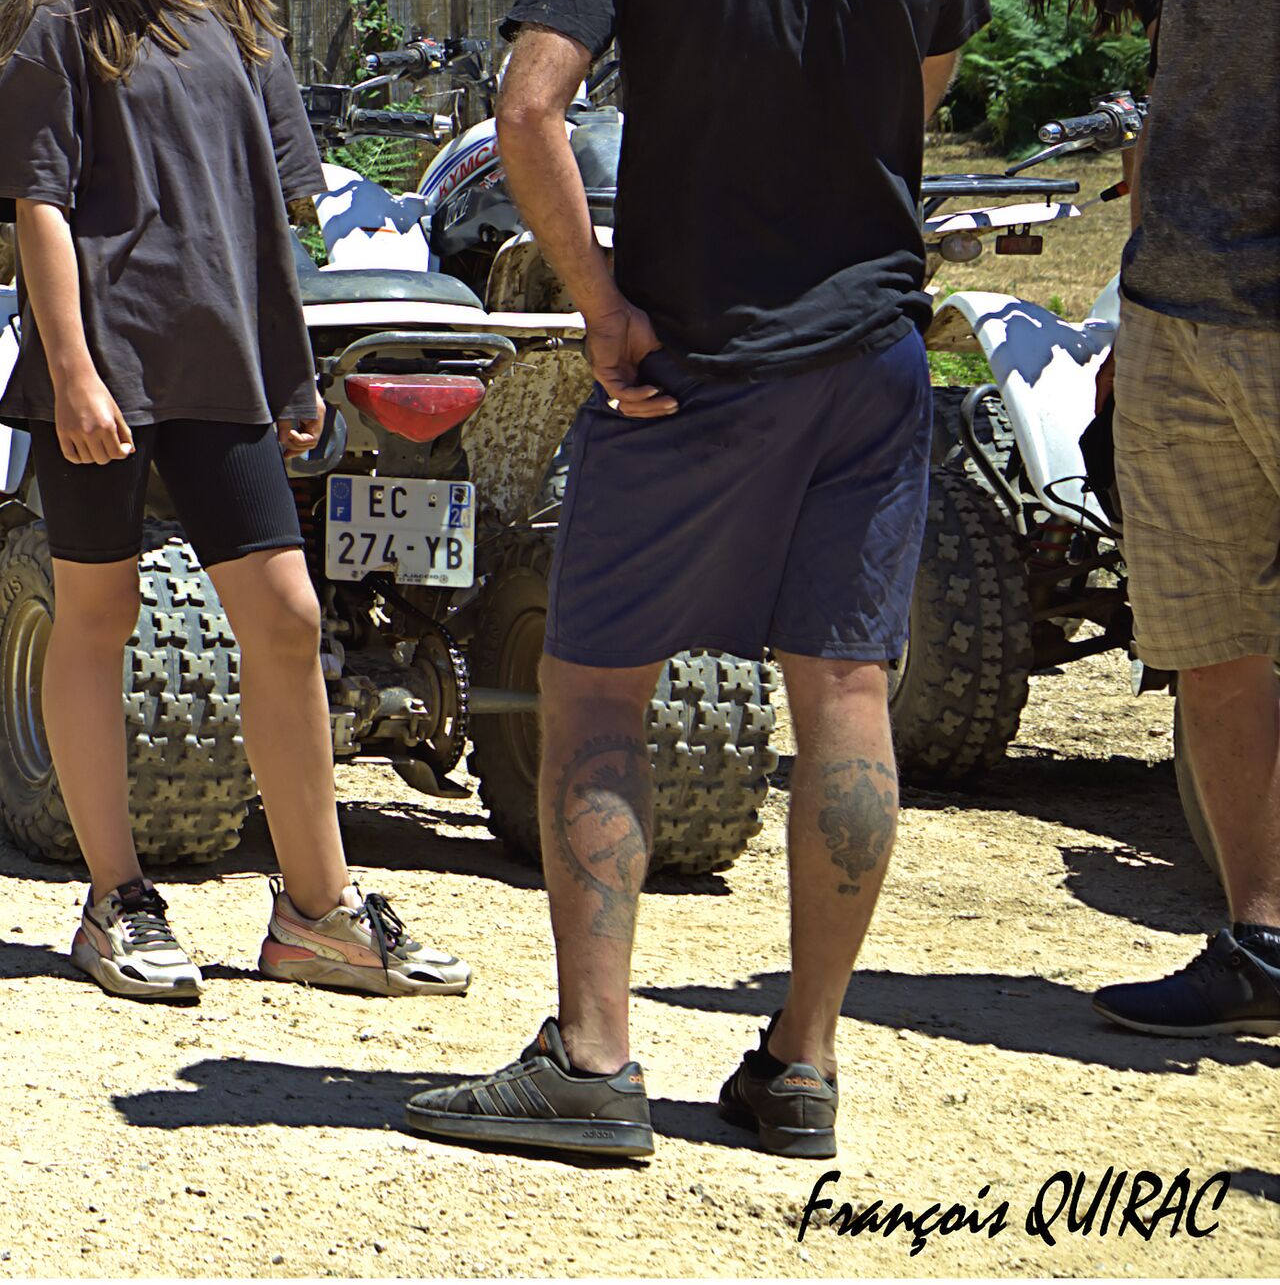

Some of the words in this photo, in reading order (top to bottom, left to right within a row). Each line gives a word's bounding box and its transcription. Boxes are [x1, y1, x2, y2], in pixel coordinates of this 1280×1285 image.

[336, 506, 345, 517] F
[338, 531, 463, 571] 274-YB
[783, 1076, 823, 1090] adidas
